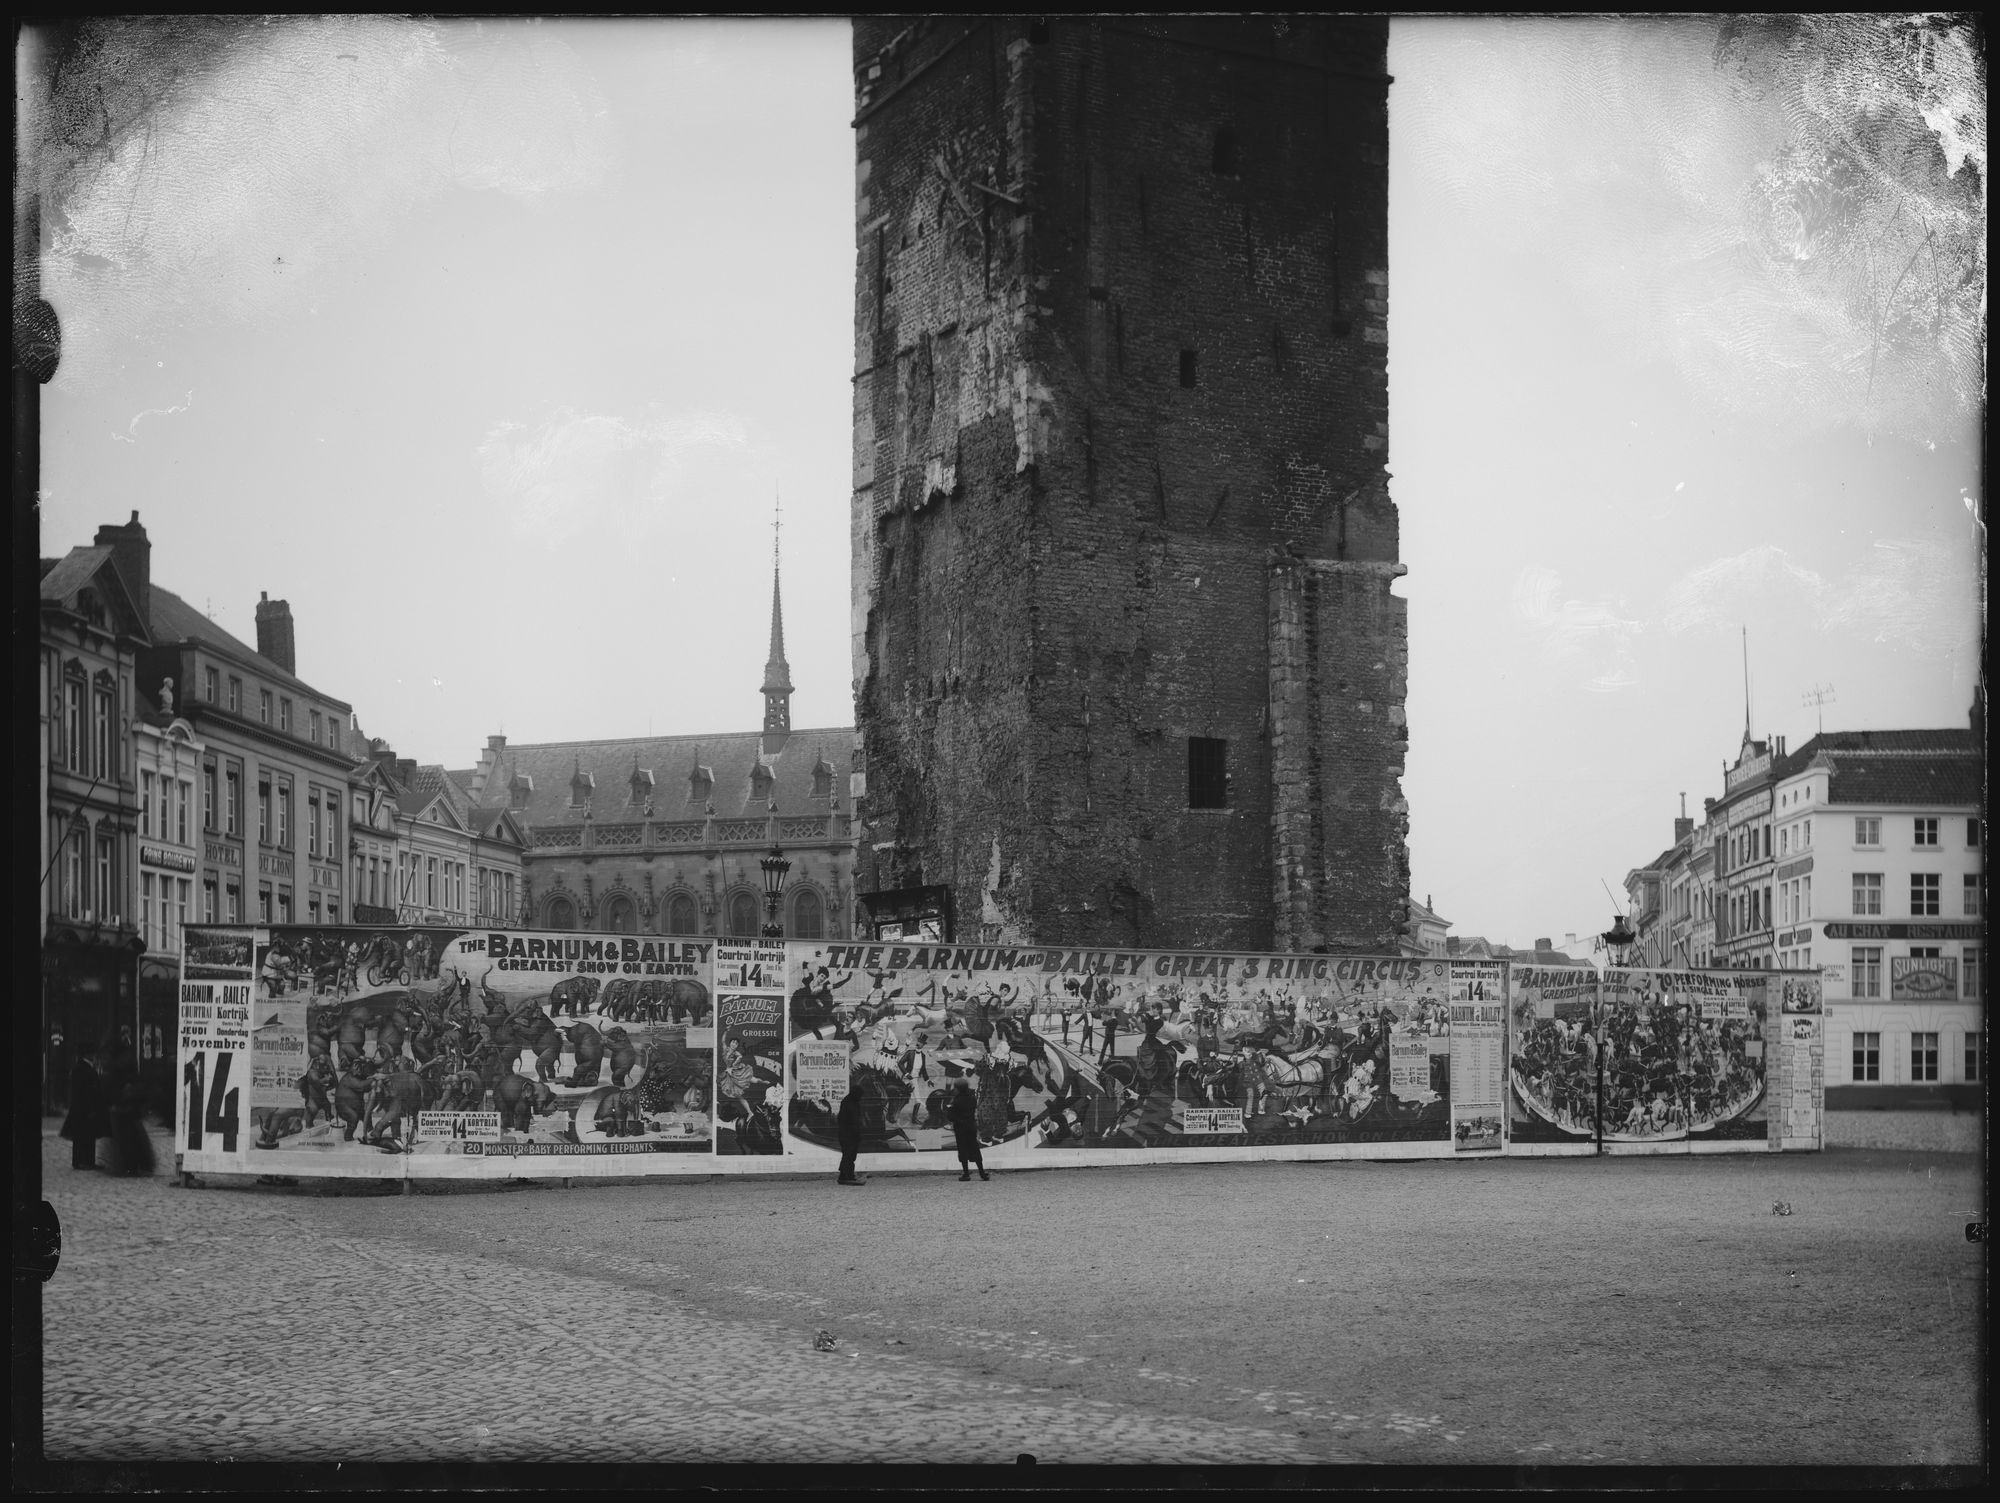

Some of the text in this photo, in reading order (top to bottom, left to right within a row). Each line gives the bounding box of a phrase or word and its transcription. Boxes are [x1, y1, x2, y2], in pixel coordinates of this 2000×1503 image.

[205, 843, 238, 865] HOTEL
[271, 858, 290, 876] LION
[1829, 925, 1847, 938] AU
[1852, 925, 1890, 938] CHAT
[459, 940, 486, 953] THE
[717, 939, 751, 947] BARNUM
[759, 941, 785, 949] BAILEY
[718, 949, 785, 964] Courtrai Kortrijk
[826, 946, 1422, 980] THE BARNUM AND BAILEY GREAT 3 RING CIRCUS
[498, 958, 698, 975] GREATEST SHOW ON EARTH.
[740, 963, 762, 987] 14
[1451, 970, 1475, 979] Courtrai
[1895, 959, 1954, 979] SUNLIGHT
[1520, 968, 1576, 988] BARNUM
[1656, 973, 1766, 992] 70 PERFORMING HORSES
[182, 984, 213, 1003] BARNUM
[223, 985, 250, 1005] BAILEY
[1468, 981, 1484, 1001] 14
[1543, 988, 1578, 1000] GREATEST
[1682, 985, 1687, 993] A
[1715, 988, 1728, 996] ACT
[181, 1005, 249, 1022] COURTRAI Kortrijk
[720, 999, 777, 1017] BARNUM
[734, 1011, 782, 1025] BAILEY
[181, 1026, 249, 1038] JEUDI Donderdag
[182, 1037, 246, 1050] Novembre
[184, 1052, 240, 1152] 14
[421, 1118, 498, 1139] Courtrai 14 KORTRIJK
[1208, 1113, 1218, 1131] 14
[466, 1143, 480, 1153] 20
[529, 1144, 551, 1154] BABY
[553, 1143, 607, 1154] PERFORMING
[611, 1143, 656, 1153] ELEPHANTS.
